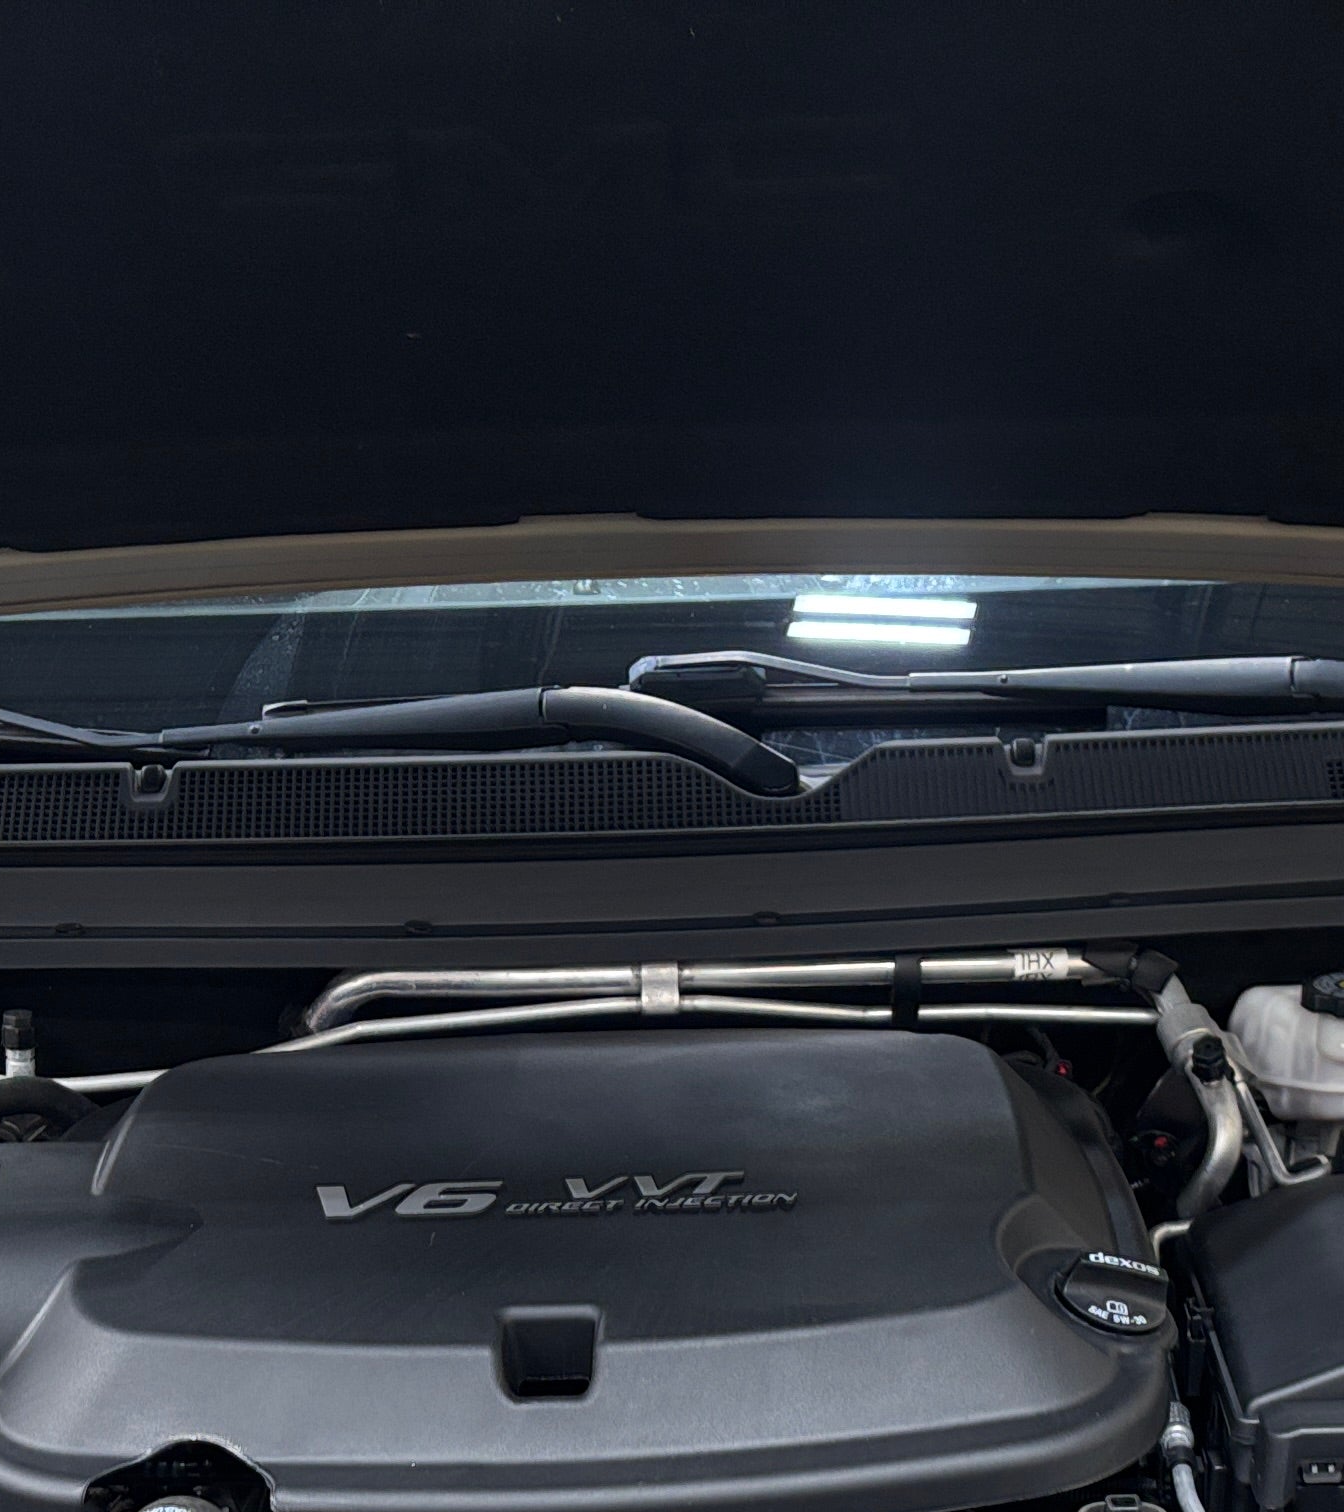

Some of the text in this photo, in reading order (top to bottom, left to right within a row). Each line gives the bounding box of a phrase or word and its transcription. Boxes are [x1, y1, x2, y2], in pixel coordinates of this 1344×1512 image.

[316, 1170, 745, 1221] V6 VVT
[505, 1191, 798, 1215] DIRECT INJECTION
[1088, 1251, 1160, 1276] dexos
[1088, 1305, 1109, 1319] SAE
